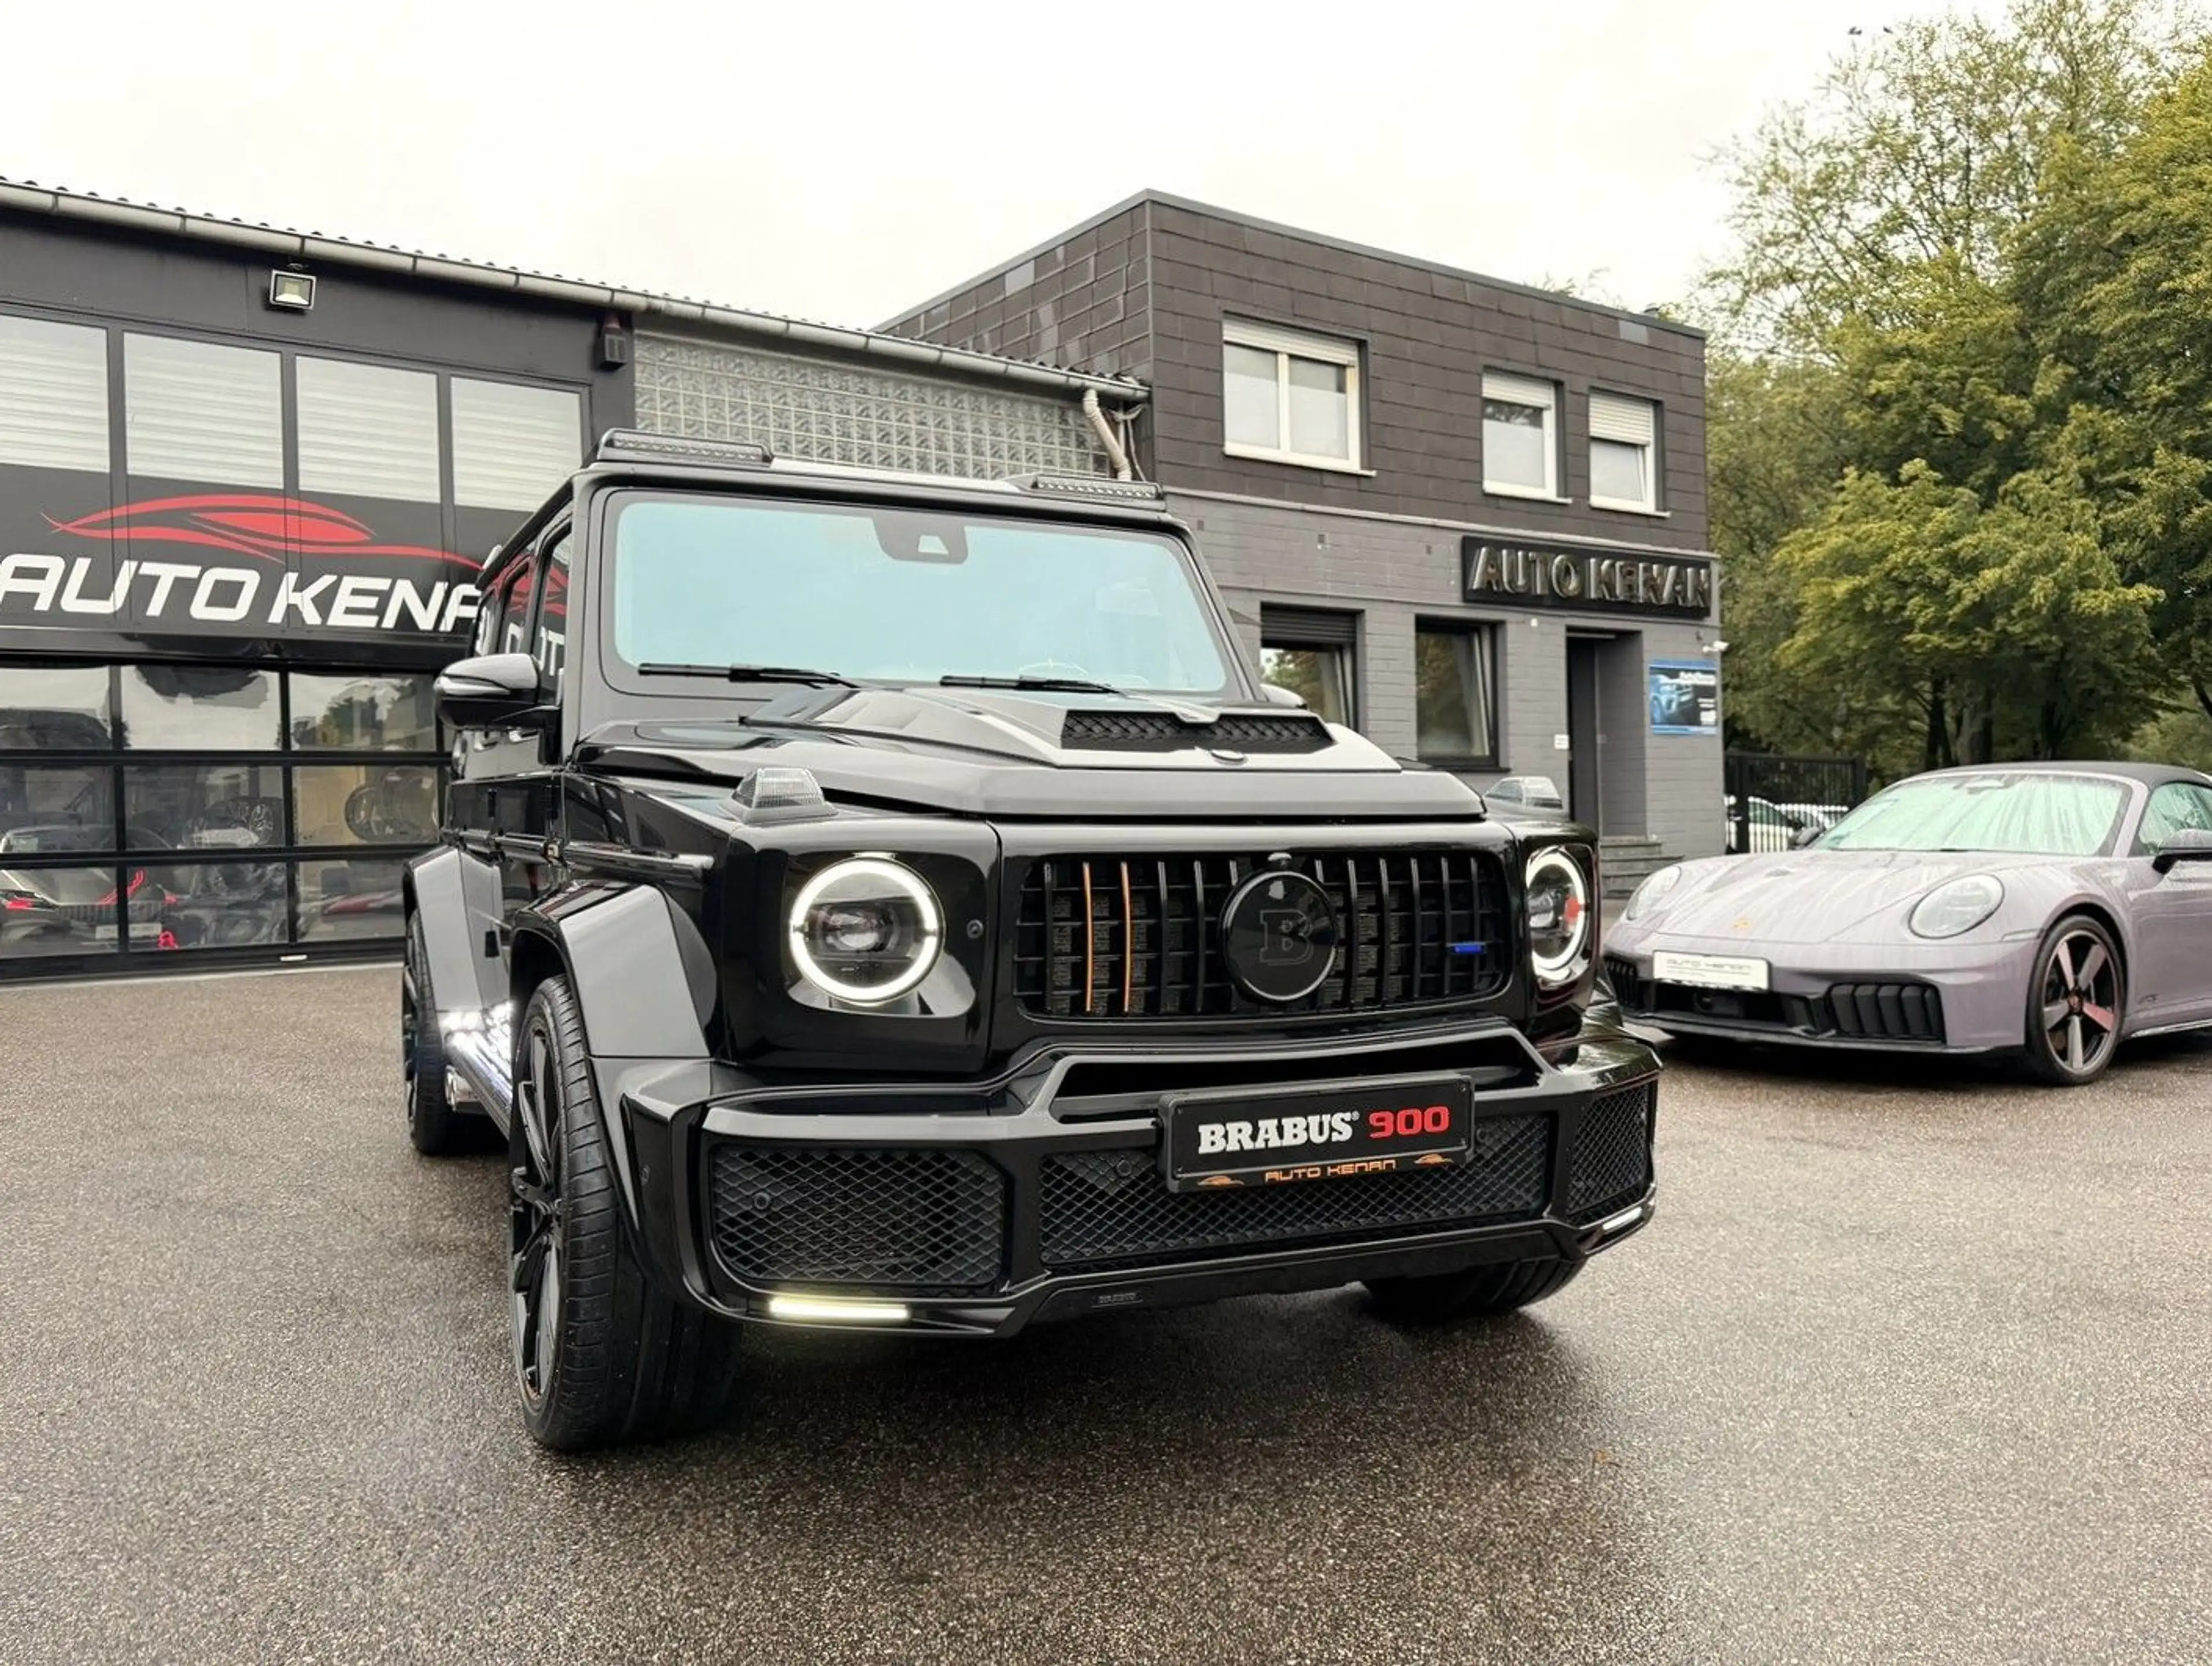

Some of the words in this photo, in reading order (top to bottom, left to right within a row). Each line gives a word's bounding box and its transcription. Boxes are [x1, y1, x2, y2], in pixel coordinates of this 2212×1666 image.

[0, 553, 261, 621] AUTO
[1468, 547, 1581, 598] AUTO
[1369, 1106, 1449, 1138] 900
[1265, 1167, 1321, 1183] AUTO
[1327, 1159, 1396, 1177] KENAN
